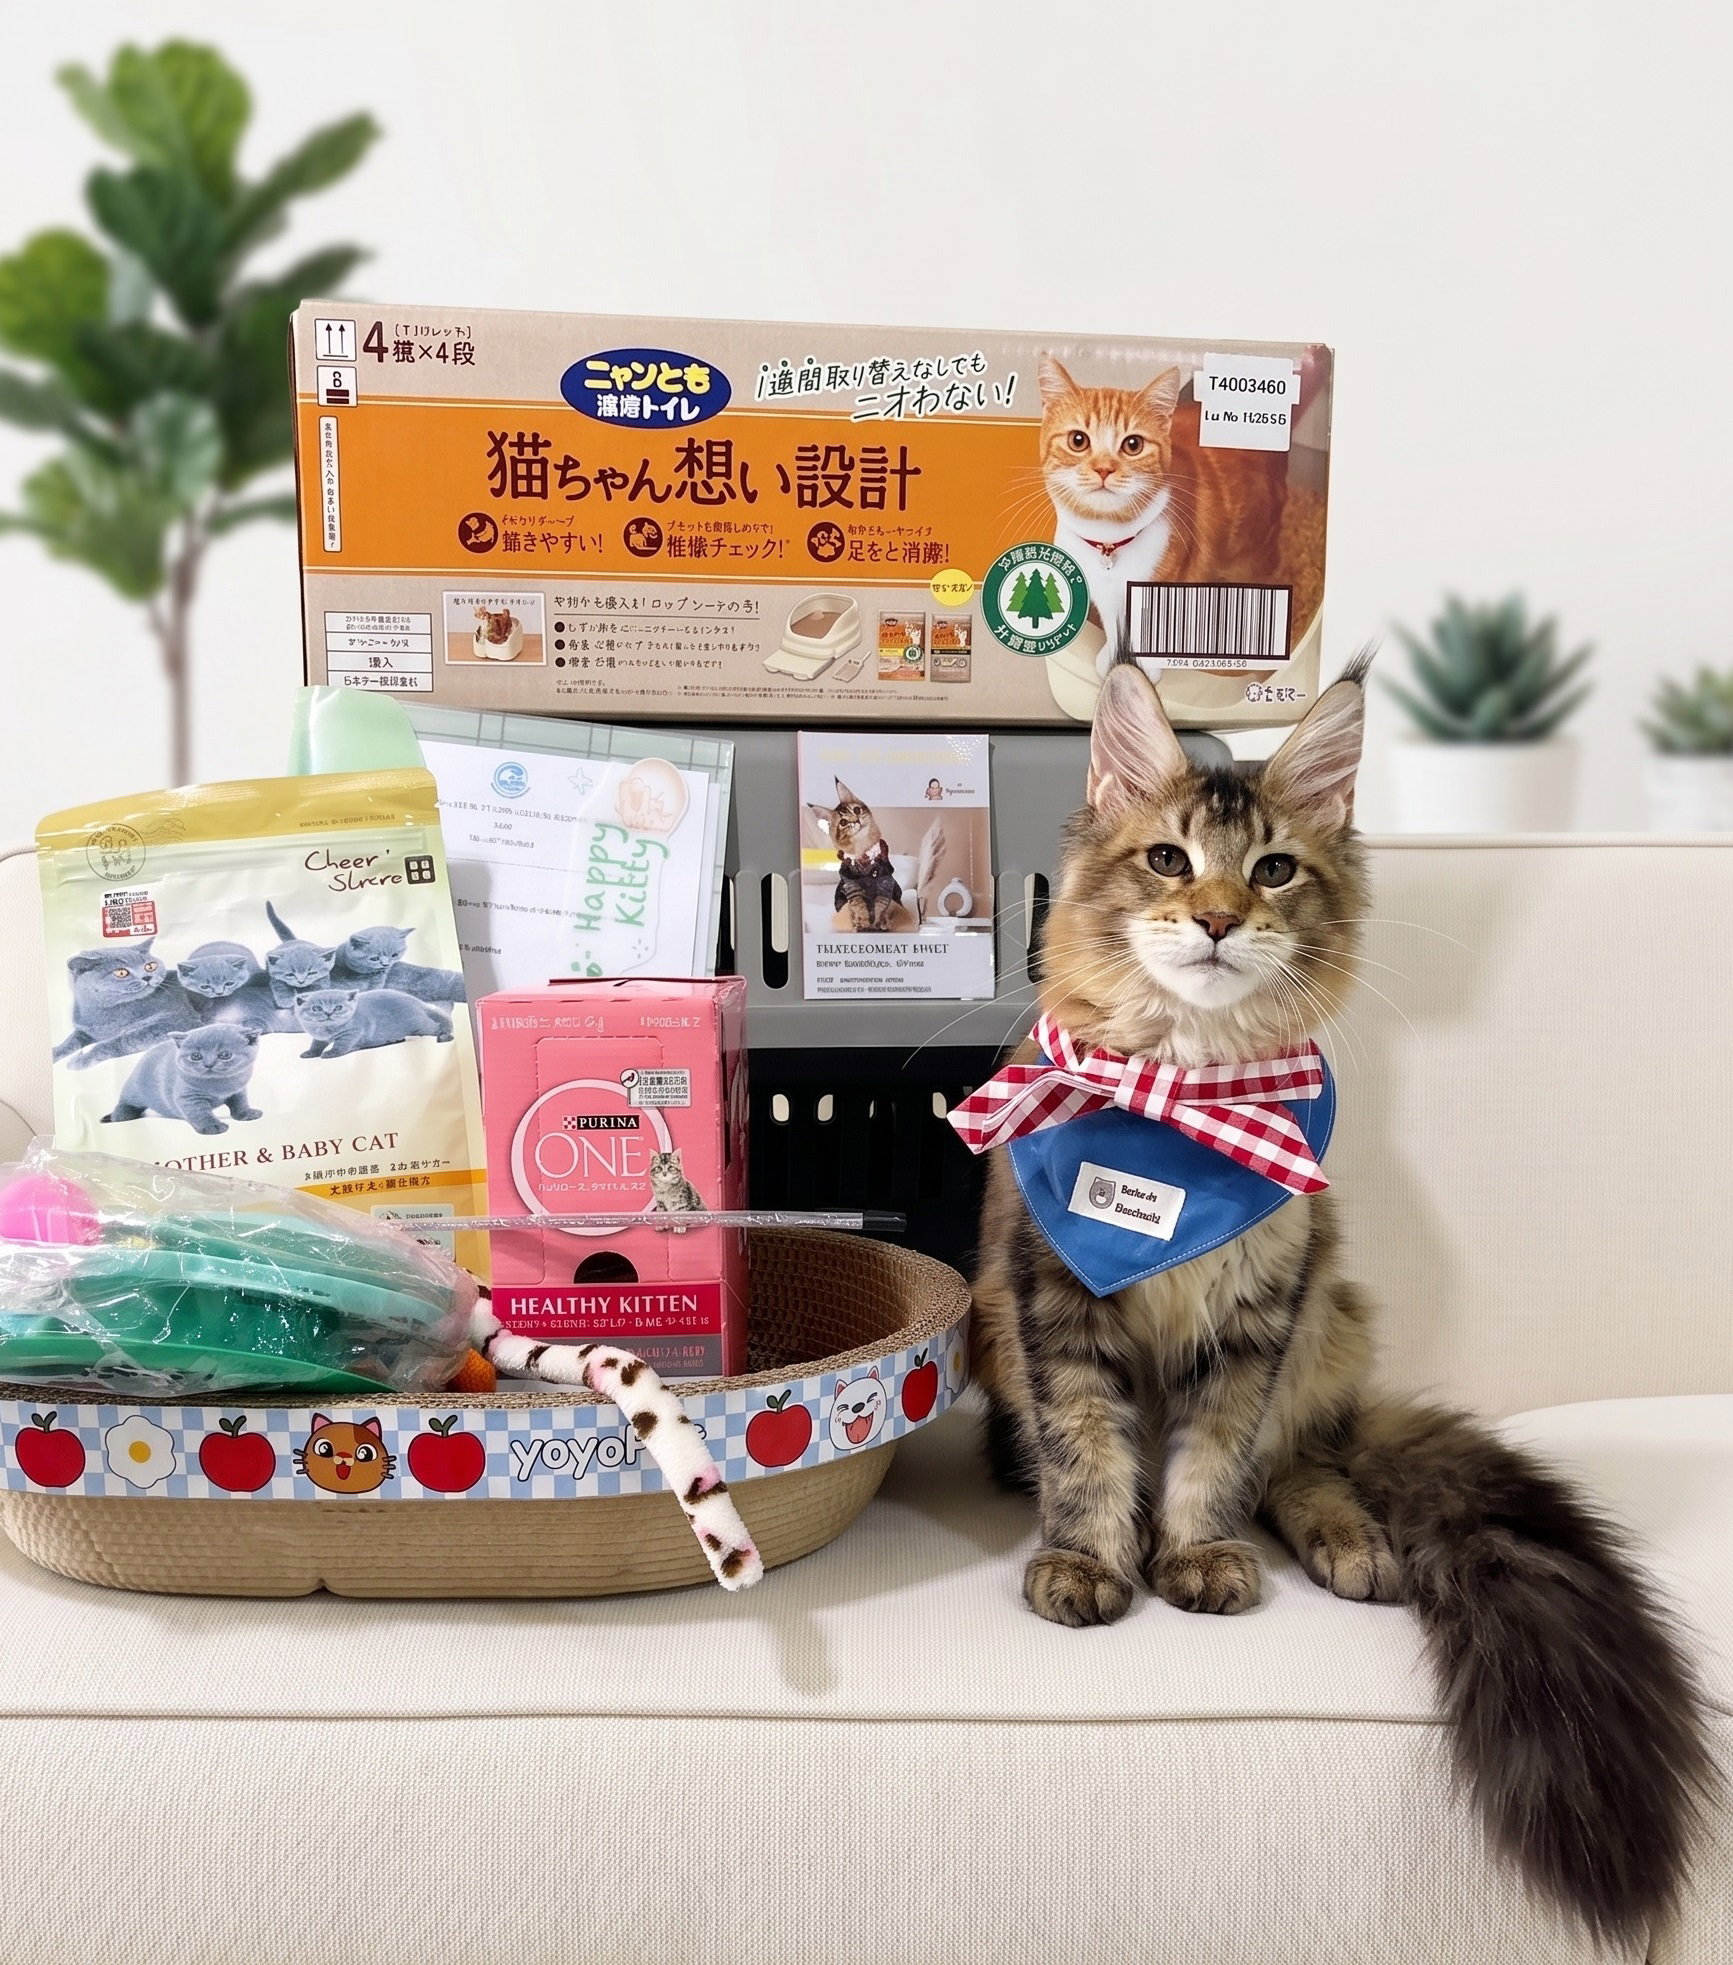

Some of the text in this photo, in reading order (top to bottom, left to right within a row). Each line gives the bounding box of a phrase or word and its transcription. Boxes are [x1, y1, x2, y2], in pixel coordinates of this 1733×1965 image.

[584, 360, 712, 395] ニャンとも
[1208, 376, 1287, 395] T4003460
[487, 430, 923, 512] 猫ちゃん想い設計
[573, 821, 629, 932] Happy
[614, 838, 670, 928] Kitty
[579, 1117, 638, 1129] PURINA
[154, 1132, 400, 1171] OTHER & BABY CAT
[534, 1131, 648, 1179] ONE
[511, 1295, 697, 1315] HEALTHY KITTEN
